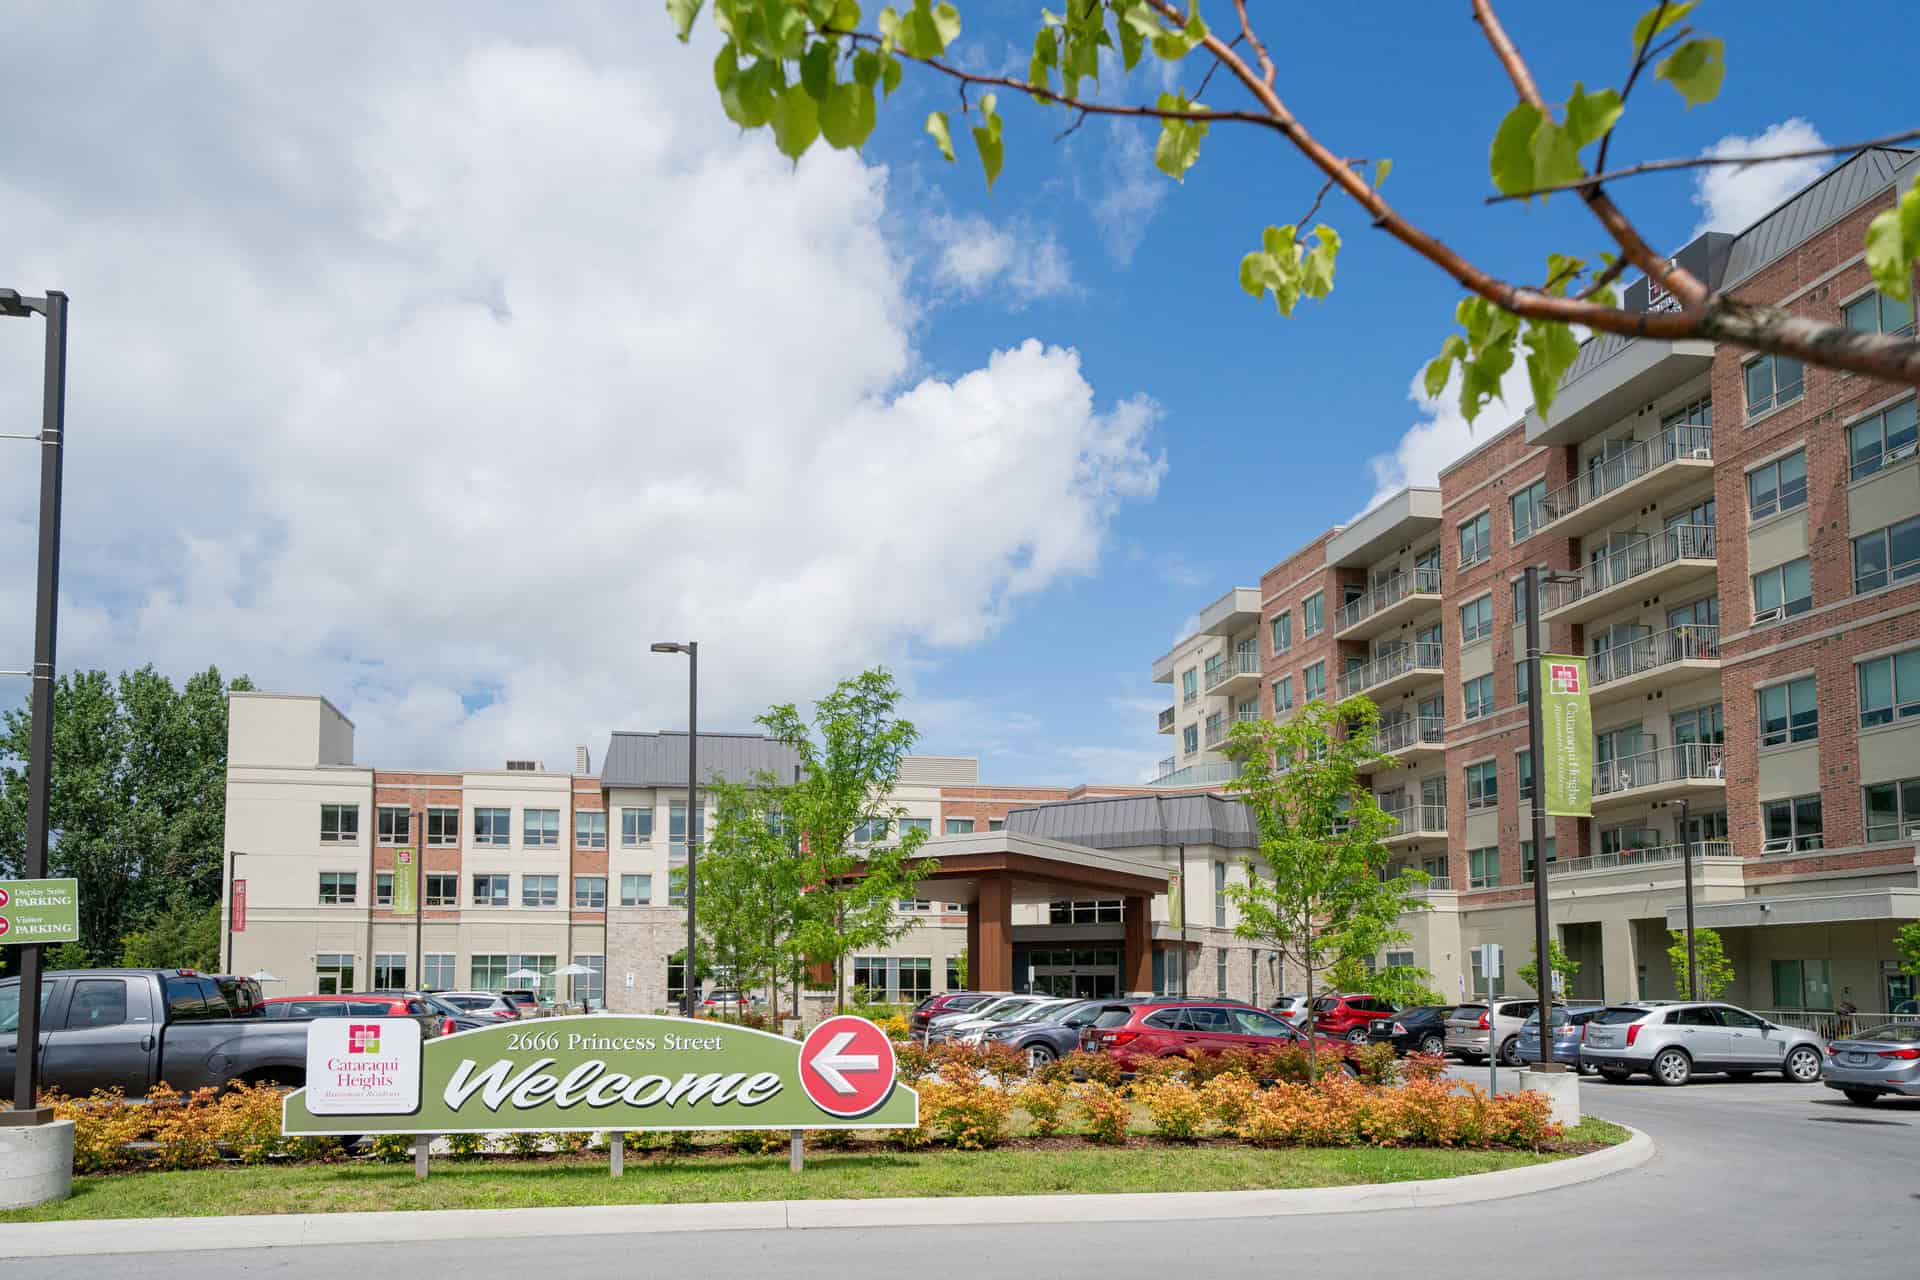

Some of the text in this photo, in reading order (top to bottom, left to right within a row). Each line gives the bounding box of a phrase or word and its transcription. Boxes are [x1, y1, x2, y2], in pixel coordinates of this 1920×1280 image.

[15, 896, 71, 906] PARKING
[15, 923, 71, 934] PARKING
[506, 1032, 723, 1051] 2666 Princess Street
[327, 1057, 399, 1075] Cataraqui
[337, 1073, 393, 1090] Heights
[443, 1057, 781, 1112] Welcome
